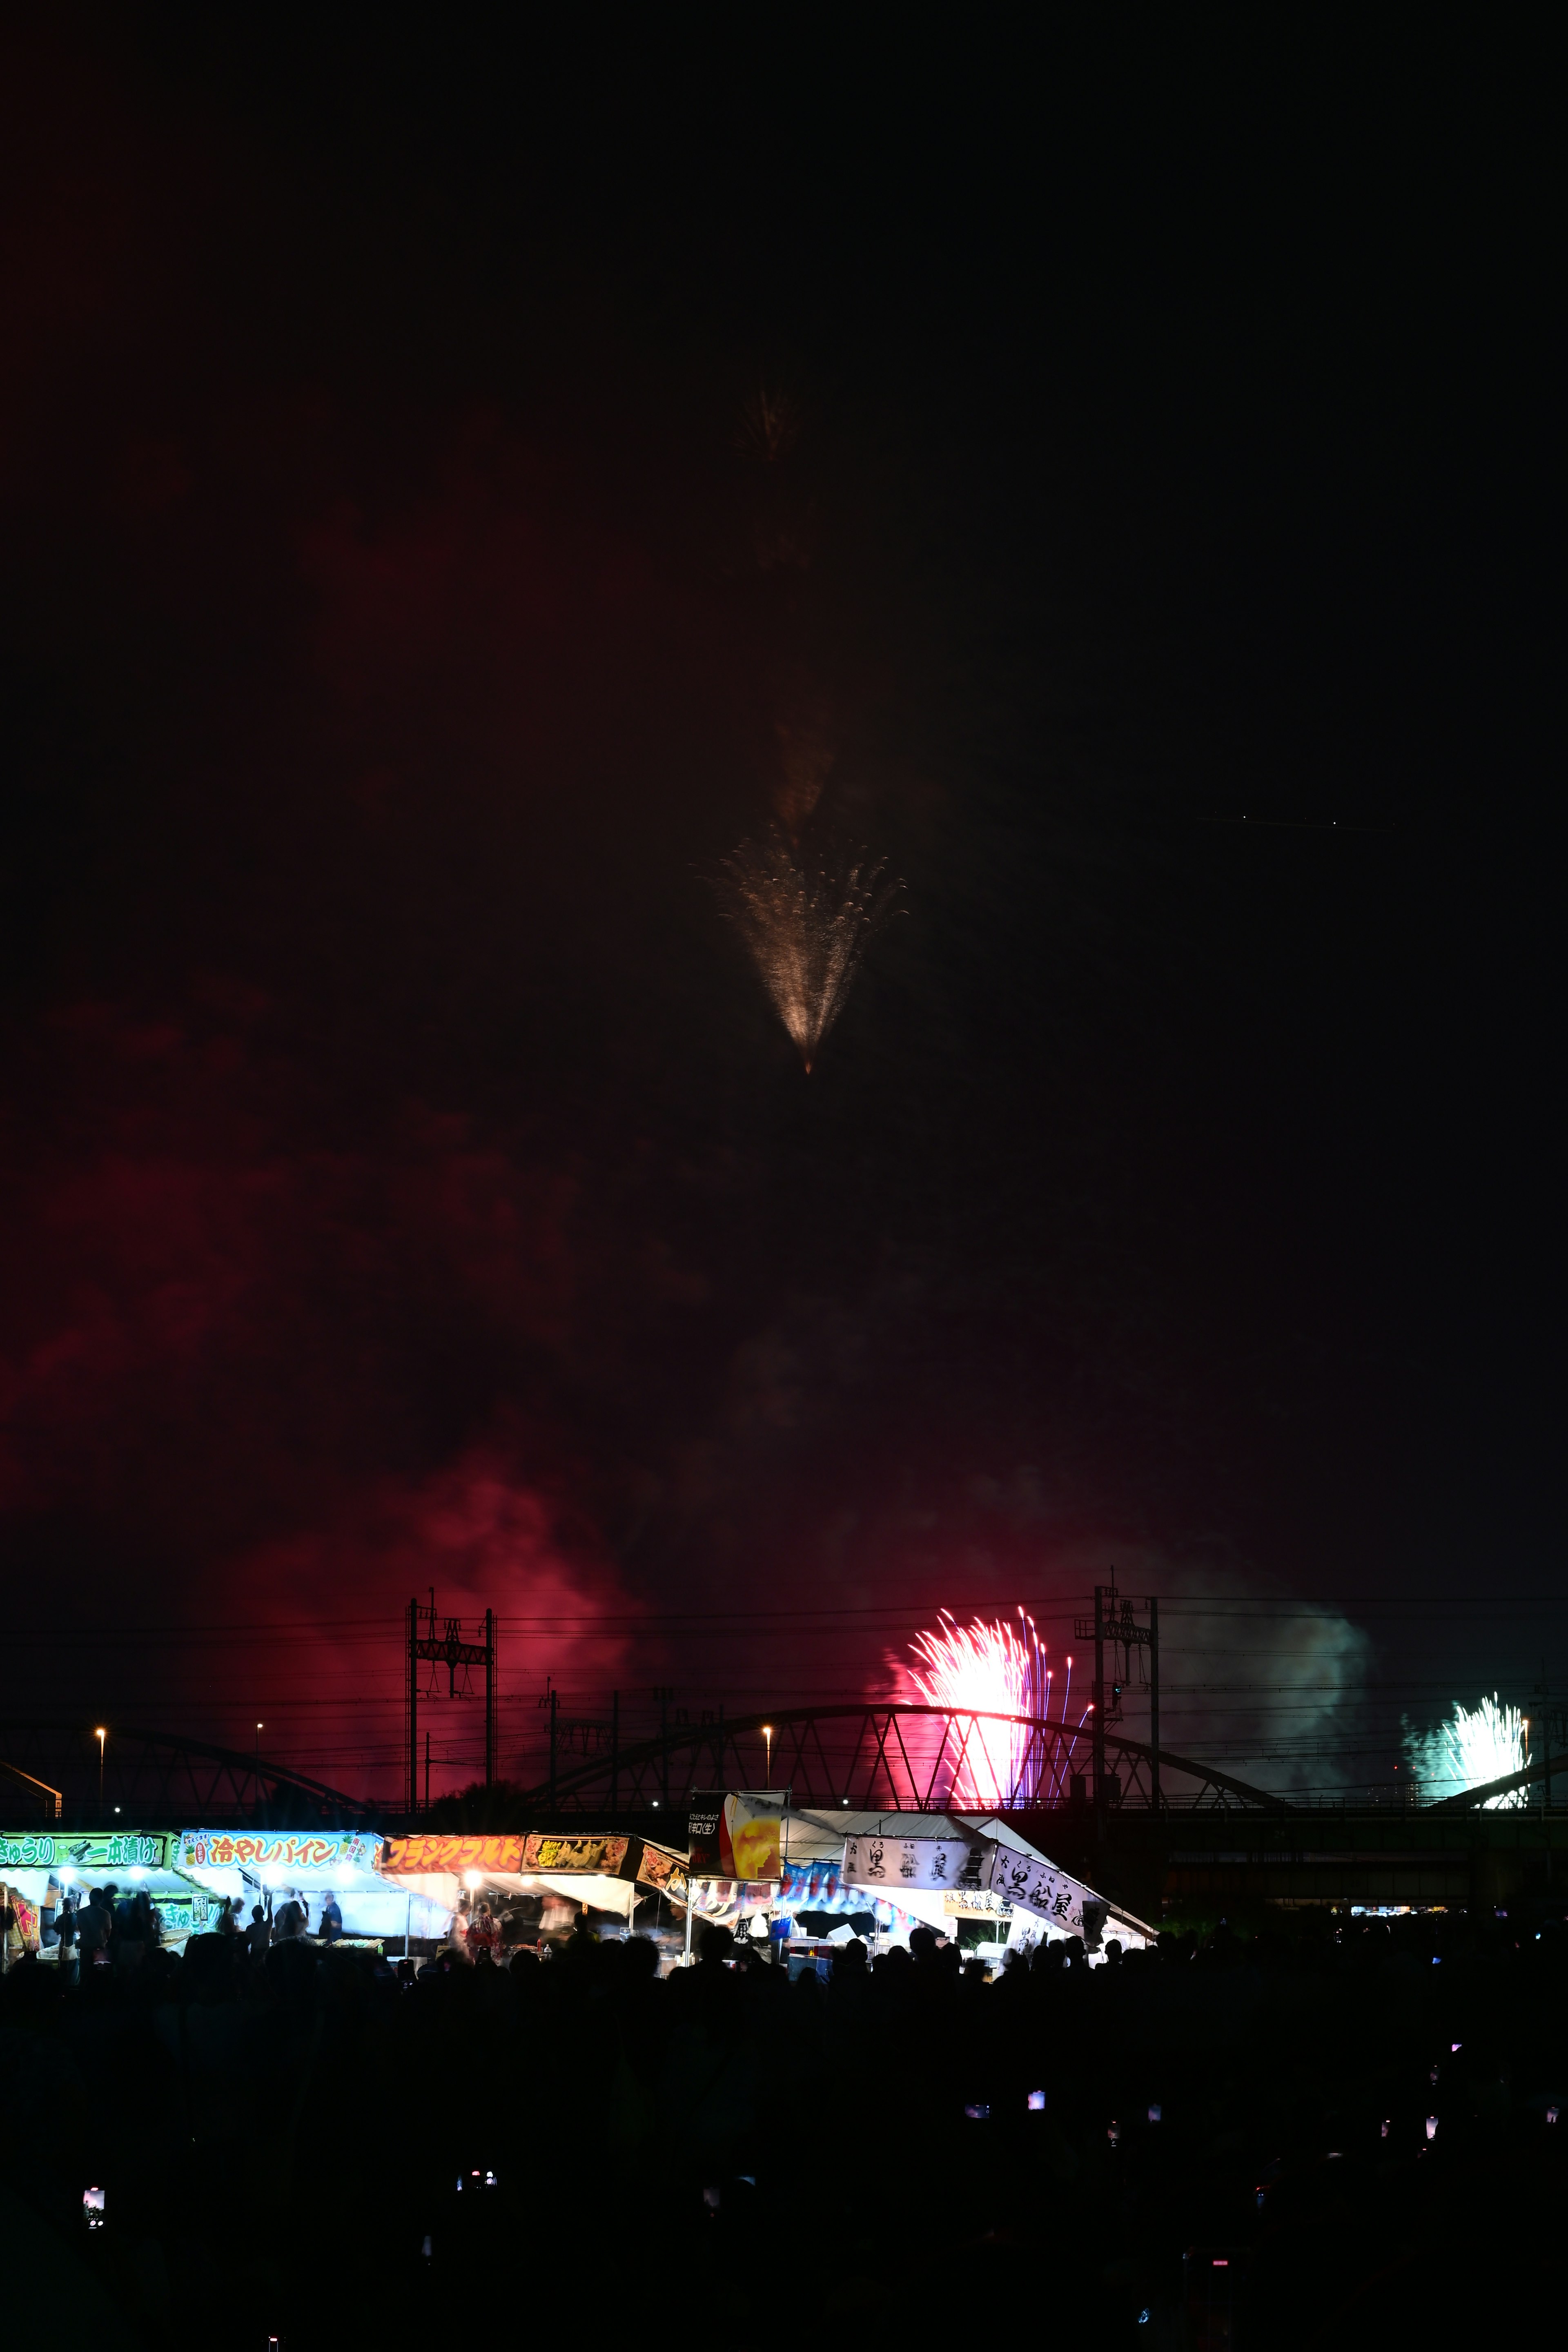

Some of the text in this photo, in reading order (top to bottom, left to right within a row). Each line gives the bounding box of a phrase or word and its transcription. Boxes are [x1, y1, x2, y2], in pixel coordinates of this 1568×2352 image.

[0, 1837, 55, 1865] きゅうり
[85, 1836, 156, 1865] 一本漬け
[211, 1838, 335, 1864] 冷やしパイン
[388, 1838, 521, 1870] フランクフルト
[1007, 1867, 1073, 1922] 黒船屋
